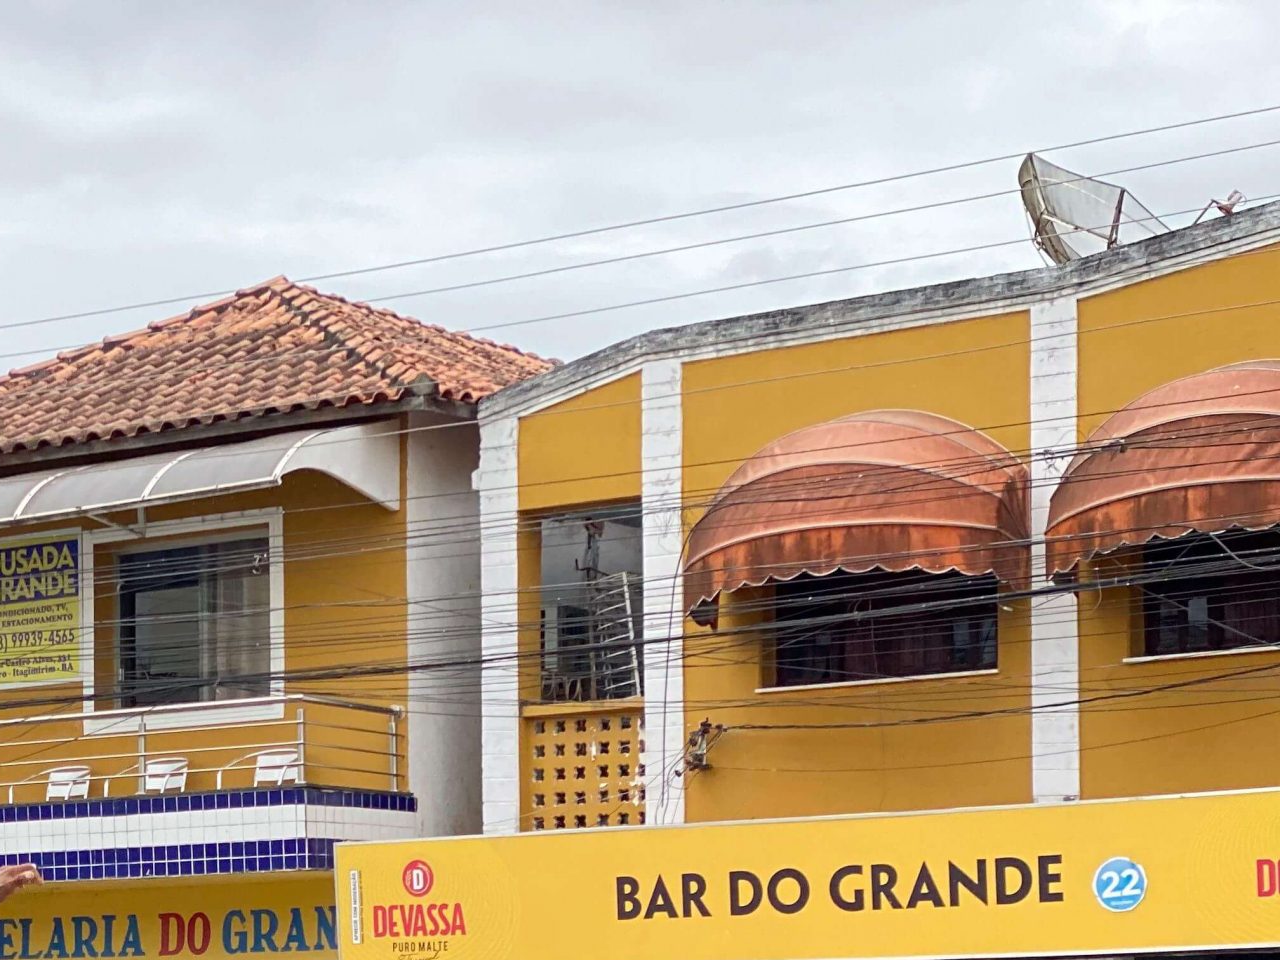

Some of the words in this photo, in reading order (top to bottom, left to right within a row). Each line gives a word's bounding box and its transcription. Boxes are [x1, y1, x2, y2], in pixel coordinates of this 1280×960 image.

[1, 613, 73, 628] ESTACIONAMENTO
[61, 662, 74, 671] BA
[616, 873, 713, 921] BAR
[729, 867, 810, 916] DO
[829, 854, 1064, 912] GRANDE
[1100, 868, 1142, 899] 22
[1256, 859, 1280, 898] D
[158, 912, 211, 956] DO
[373, 902, 466, 938] DEVASSA
[392, 942, 416, 953] PURO
[418, 940, 449, 952] MALTE
